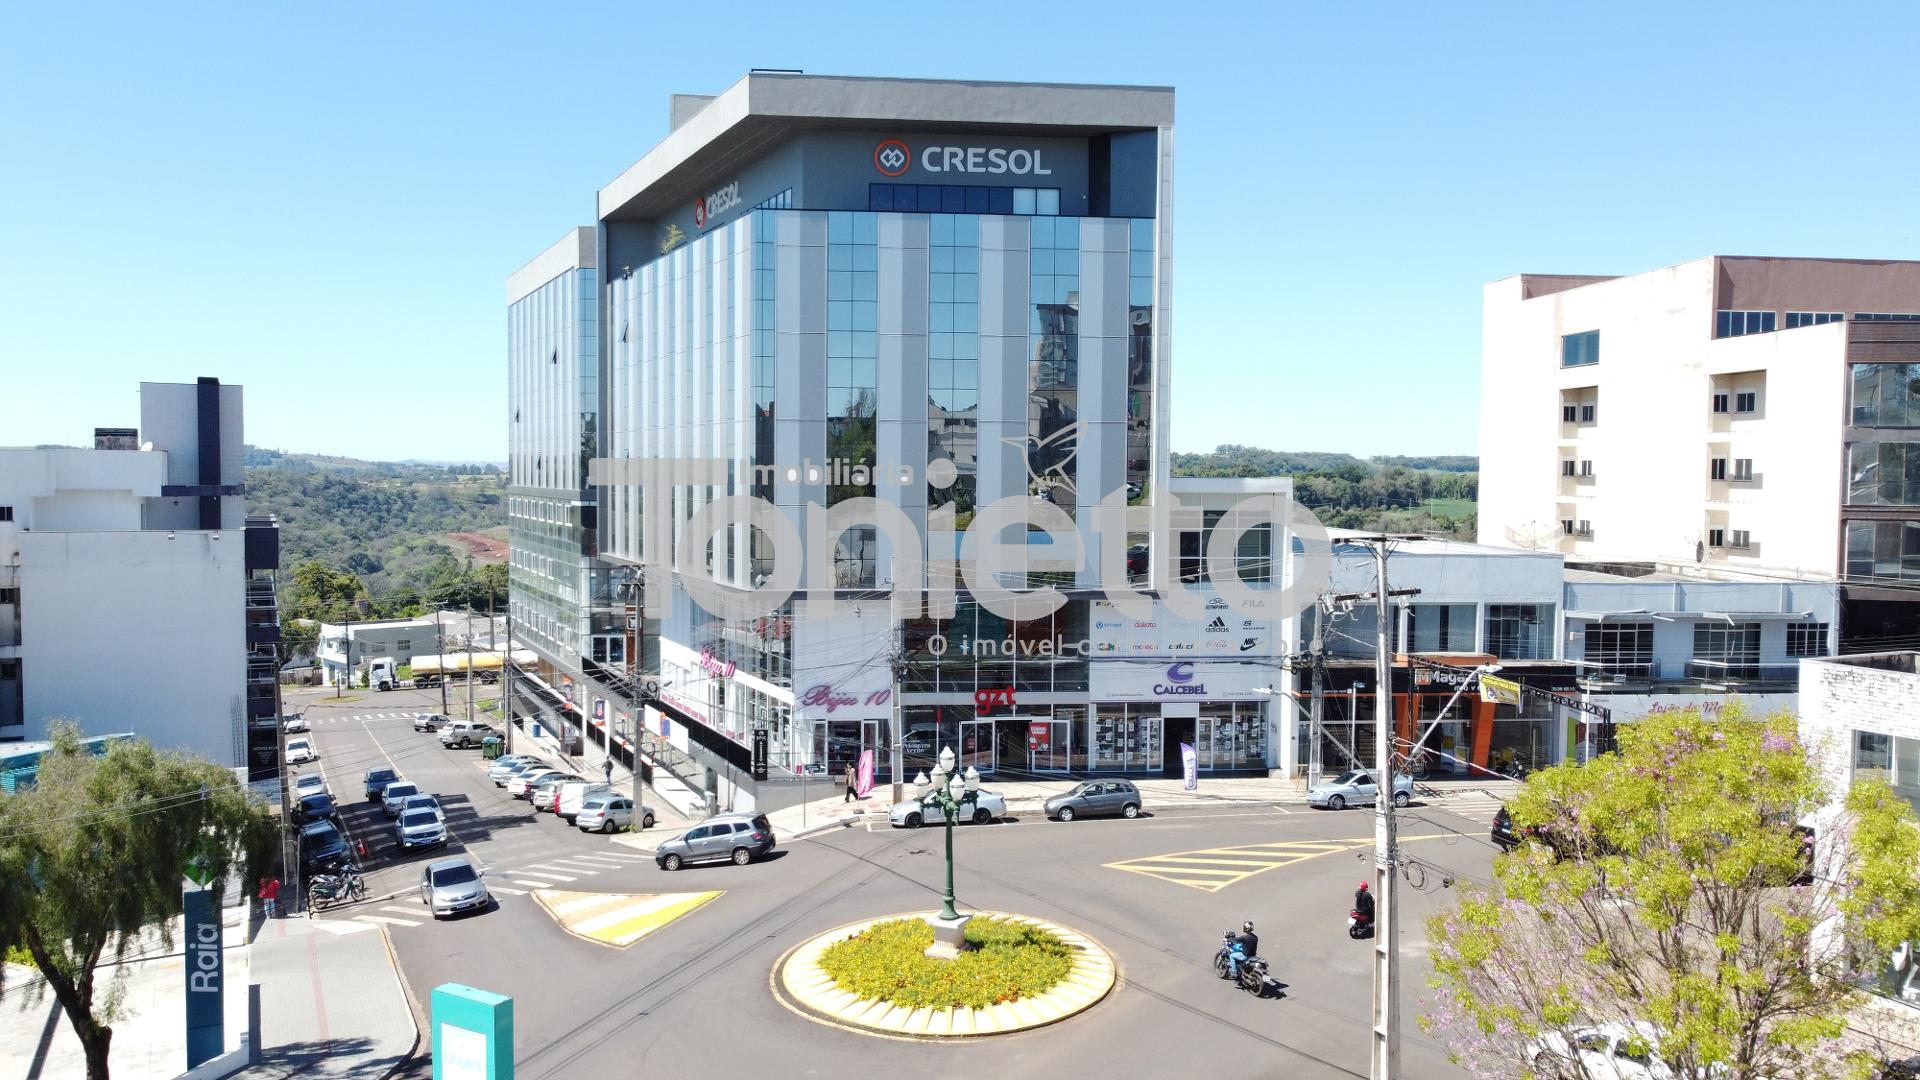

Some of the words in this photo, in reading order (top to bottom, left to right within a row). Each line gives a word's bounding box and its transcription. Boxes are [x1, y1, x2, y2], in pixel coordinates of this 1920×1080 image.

[922, 147, 1052, 175] CRESOL
[706, 181, 742, 219] CRESOL
[1242, 600, 1265, 608] FILA
[864, 689, 891, 706] 10
[975, 684, 1017, 716] gzt
[1153, 684, 1208, 696] CALCEBEL
[188, 923, 219, 993] Raia
